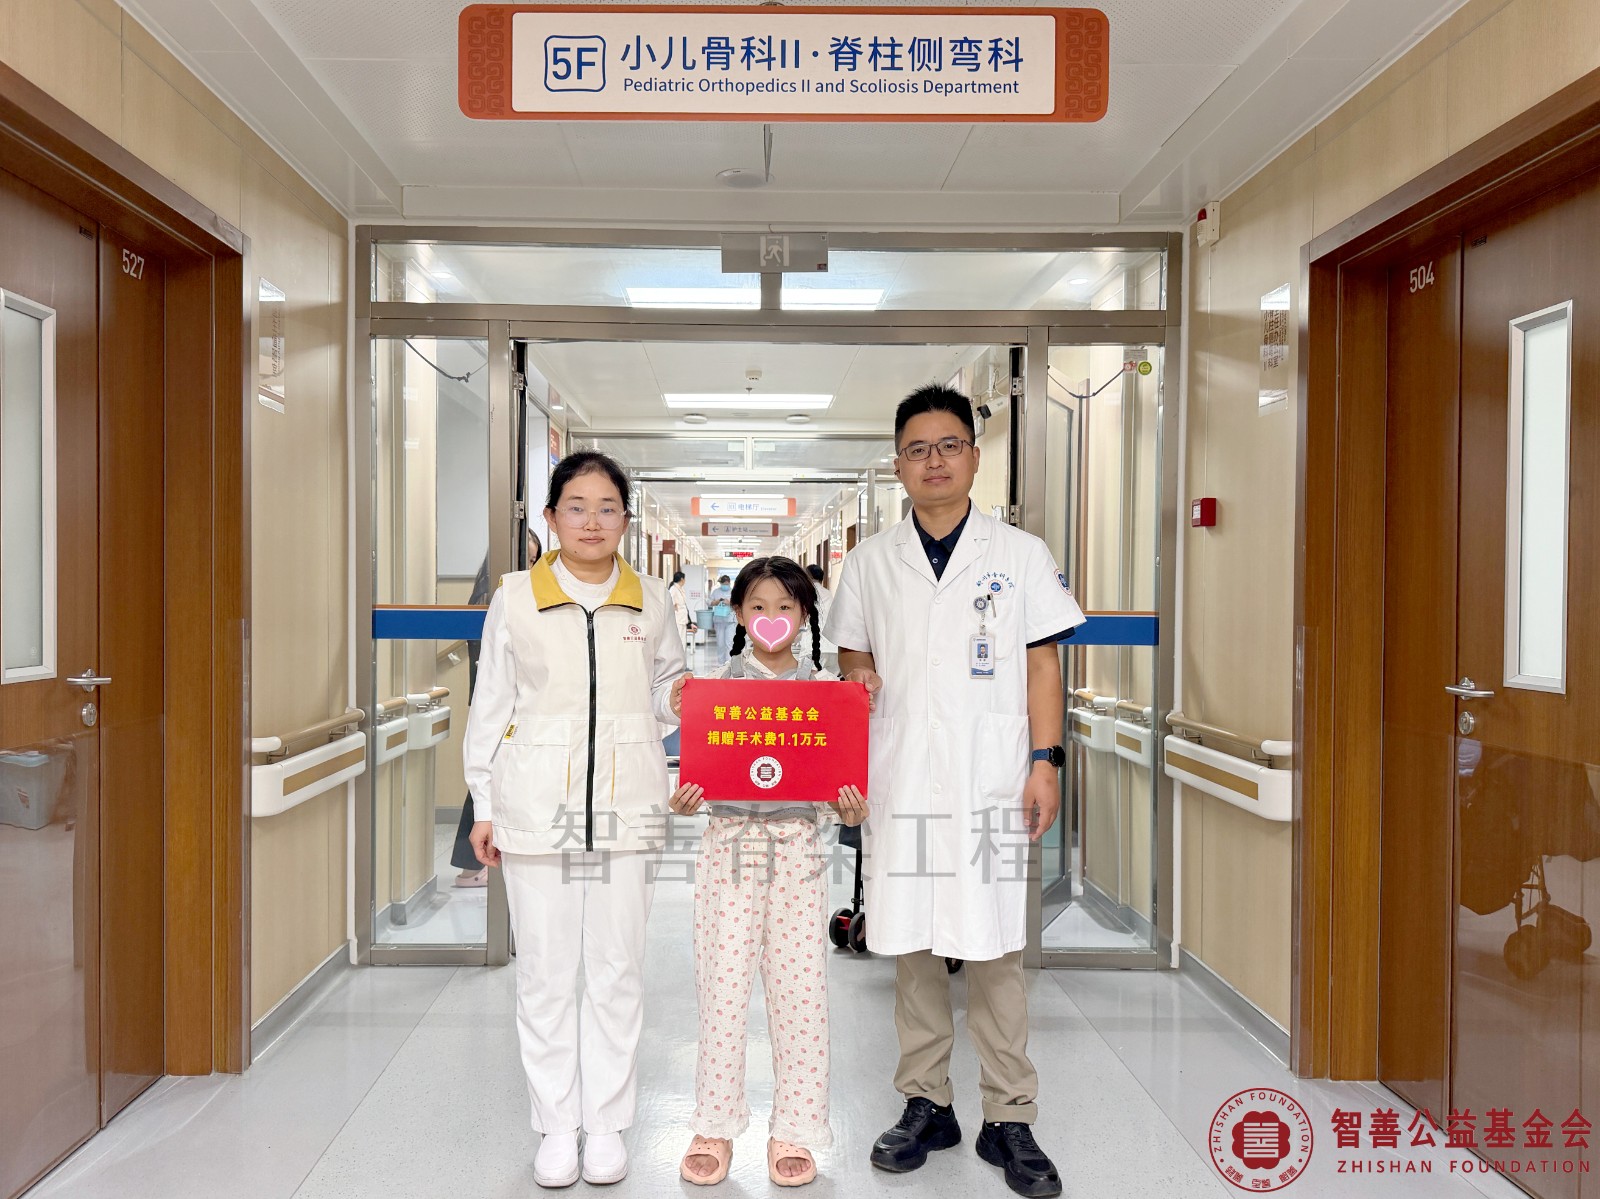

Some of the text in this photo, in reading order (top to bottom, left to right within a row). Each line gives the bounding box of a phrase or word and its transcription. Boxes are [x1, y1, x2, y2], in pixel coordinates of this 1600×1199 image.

[552, 47, 598, 80] 5F
[623, 77, 1020, 96] Pediatric Orthopedics II and Scoliosis Department
[122, 248, 145, 280] 527
[1409, 261, 1435, 293] 504
[713, 705, 820, 721] 智善公益基金会
[707, 730, 828, 747] 捐赠手术费1.1万元
